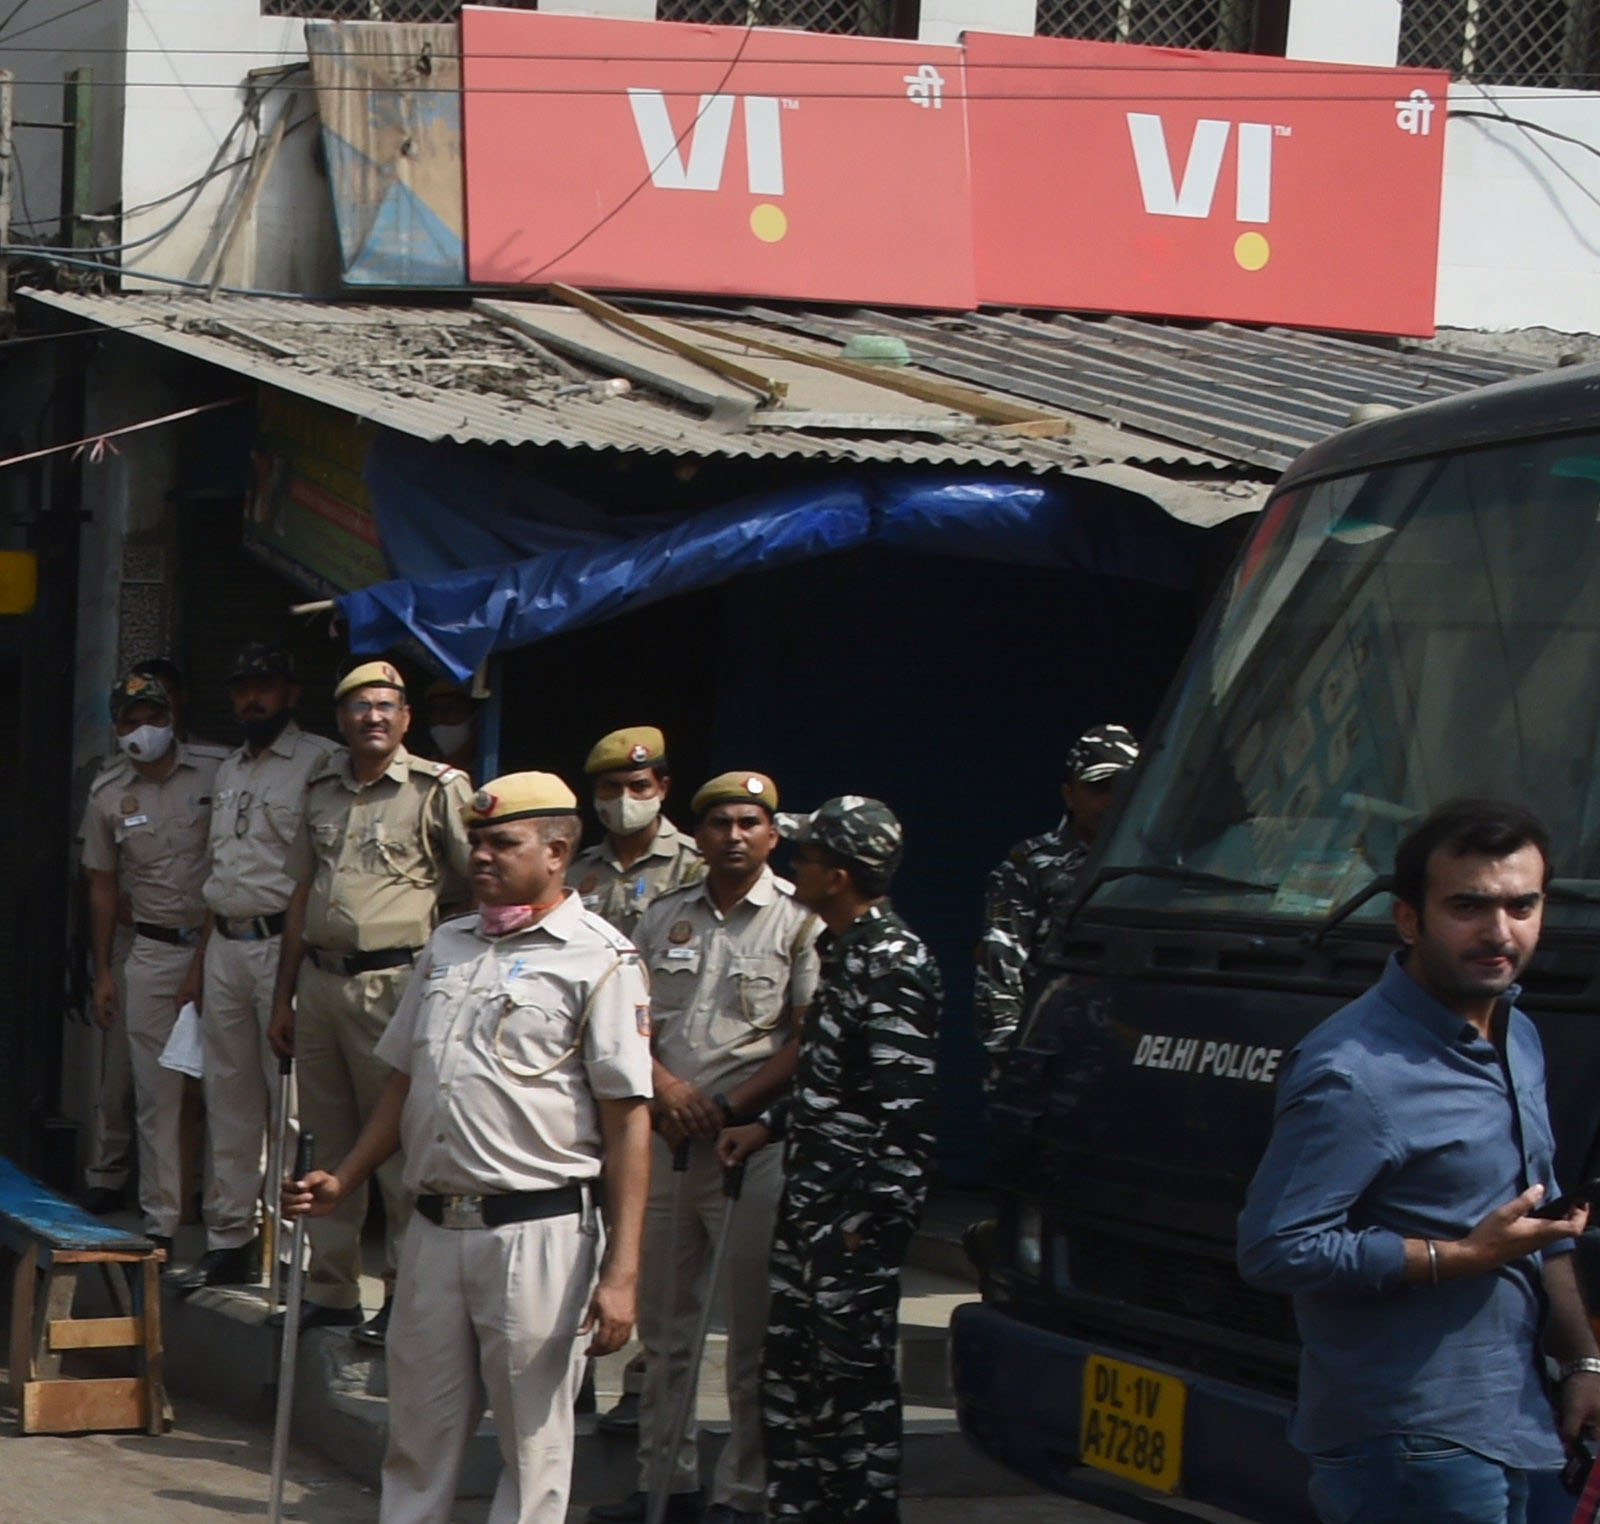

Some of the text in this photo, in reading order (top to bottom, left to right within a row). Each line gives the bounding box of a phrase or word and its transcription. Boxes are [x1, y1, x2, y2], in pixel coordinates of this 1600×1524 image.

[903, 64, 944, 109] वी
[1394, 88, 1433, 136] वी
[1133, 1033, 1283, 1083] DELHI POLICE
